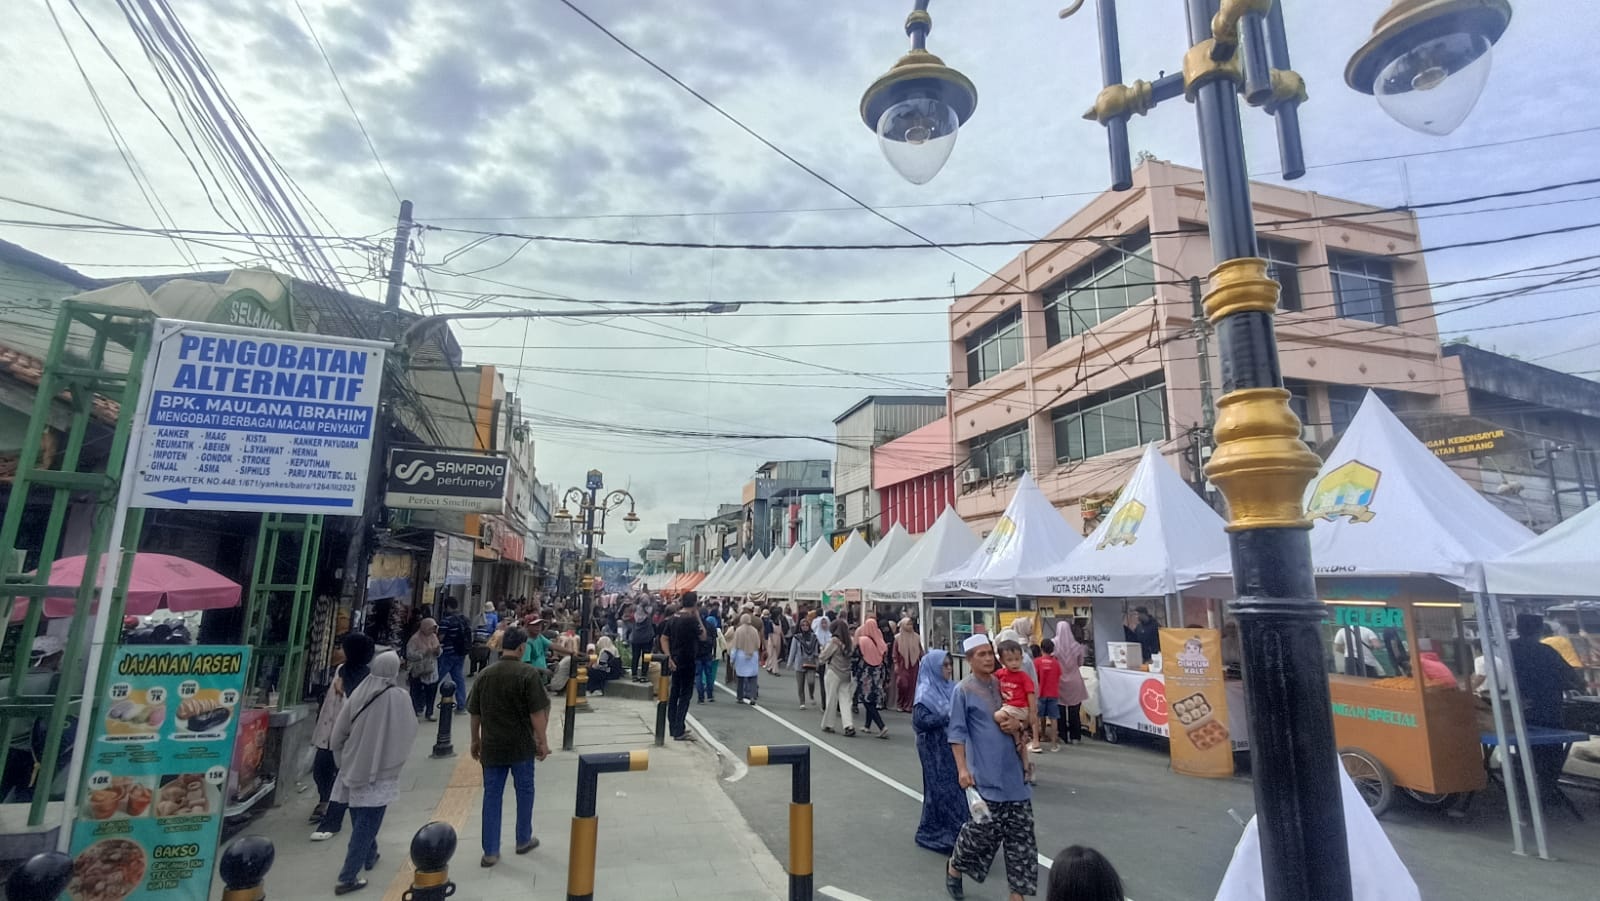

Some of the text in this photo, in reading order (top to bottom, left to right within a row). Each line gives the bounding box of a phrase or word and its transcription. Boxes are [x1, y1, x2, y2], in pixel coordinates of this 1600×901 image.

[178, 336, 367, 375] PENGOBATAN
[172, 364, 364, 401] ALTERNATIF
[159, 395, 367, 422] BPK. MAULANA IBRAHIM
[156, 411, 365, 435] MENGOBATI BERBAGAI MACAM PENYAKIT
[157, 428, 190, 439] KANKER
[204, 431, 227, 441] MAAG
[245, 434, 267, 443] KISTA
[155, 439, 194, 450] REUMATIK
[293, 437, 359, 449] KANKER PAYUDARA
[1457, 441, 1495, 453] SERANG
[153, 450, 187, 460] IMPOTEN
[292, 447, 318, 457] HERNIA
[200, 453, 233, 463] GONDOK
[241, 455, 271, 465] STROKE
[289, 458, 331, 469] KEPUTIHAN
[150, 461, 178, 471] GINJAL
[198, 464, 220, 473] ASMA
[239, 466, 271, 476] SIPHILIS
[435, 461, 504, 476] SAMPONO
[288, 468, 307, 477] PARU
[143, 474, 161, 483] IZIN
[162, 475, 204, 485] PRAKTEK
[436, 476, 496, 490] perfumery
[408, 495, 482, 509] Perfect Smelling
[1052, 583, 1104, 594] KOTA SERANG
[119, 652, 242, 675] JAJANAN ARSEN
[112, 689, 128, 697] 12K
[181, 687, 195, 695] 10K
[1367, 706, 1419, 728] SPECIAL
[208, 770, 224, 779] 15K
[92, 776, 109, 785] 10K
[153, 843, 199, 859] BAKSO
